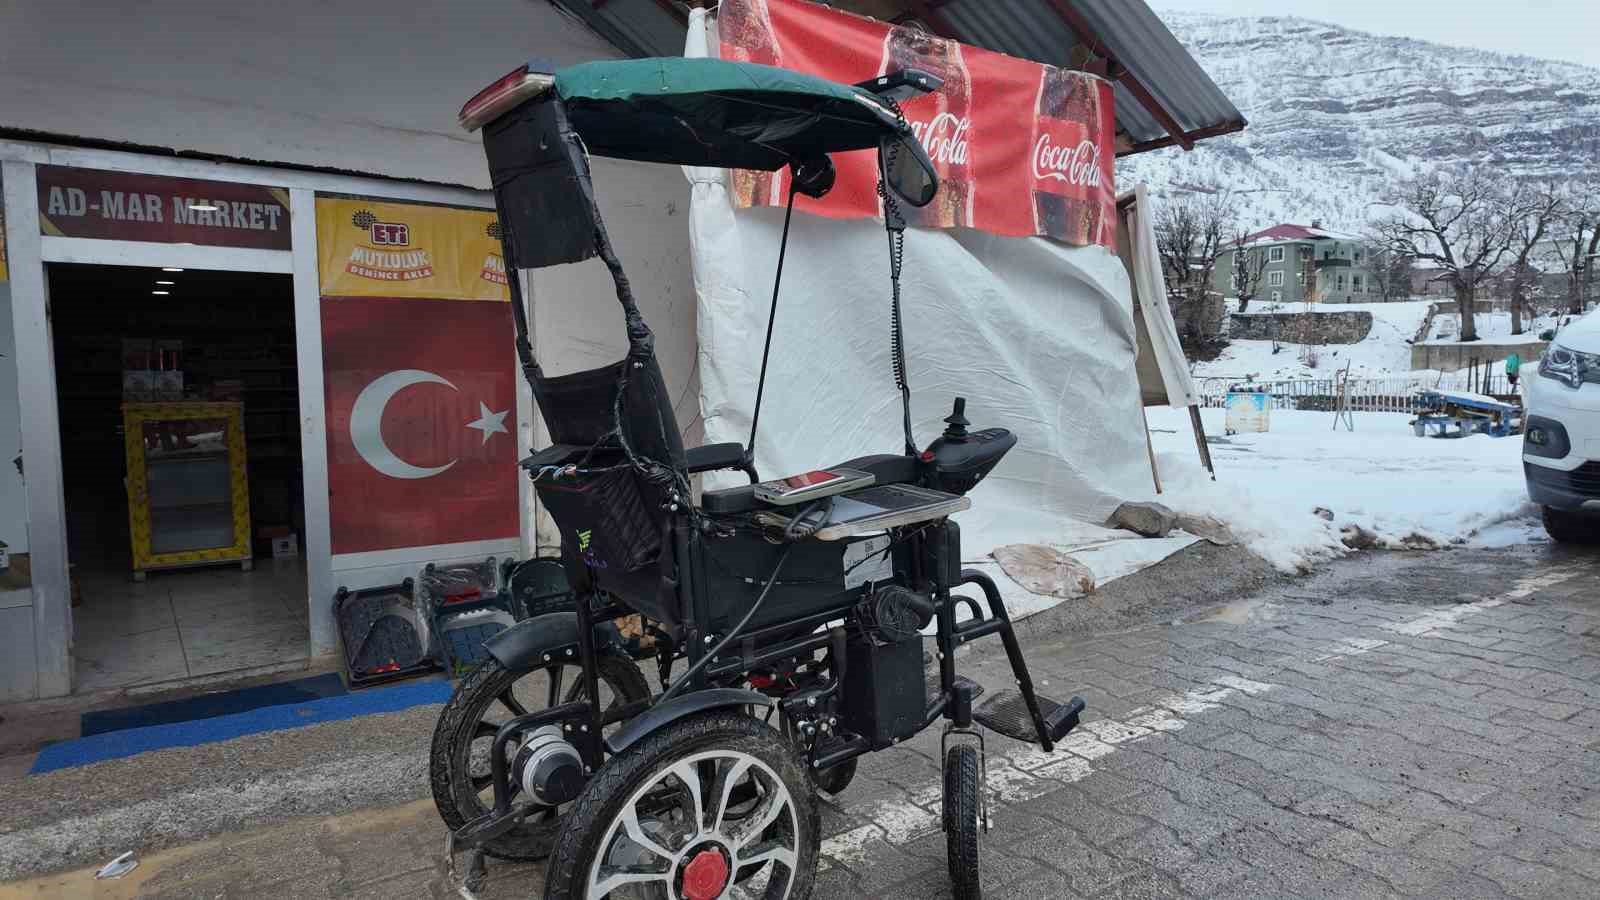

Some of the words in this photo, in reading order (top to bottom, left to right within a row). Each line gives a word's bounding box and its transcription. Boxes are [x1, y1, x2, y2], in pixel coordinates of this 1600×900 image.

[1032, 133, 1100, 188] Coca-Cola
[49, 186, 163, 223] AD-MAR
[173, 196, 281, 231] MARKET
